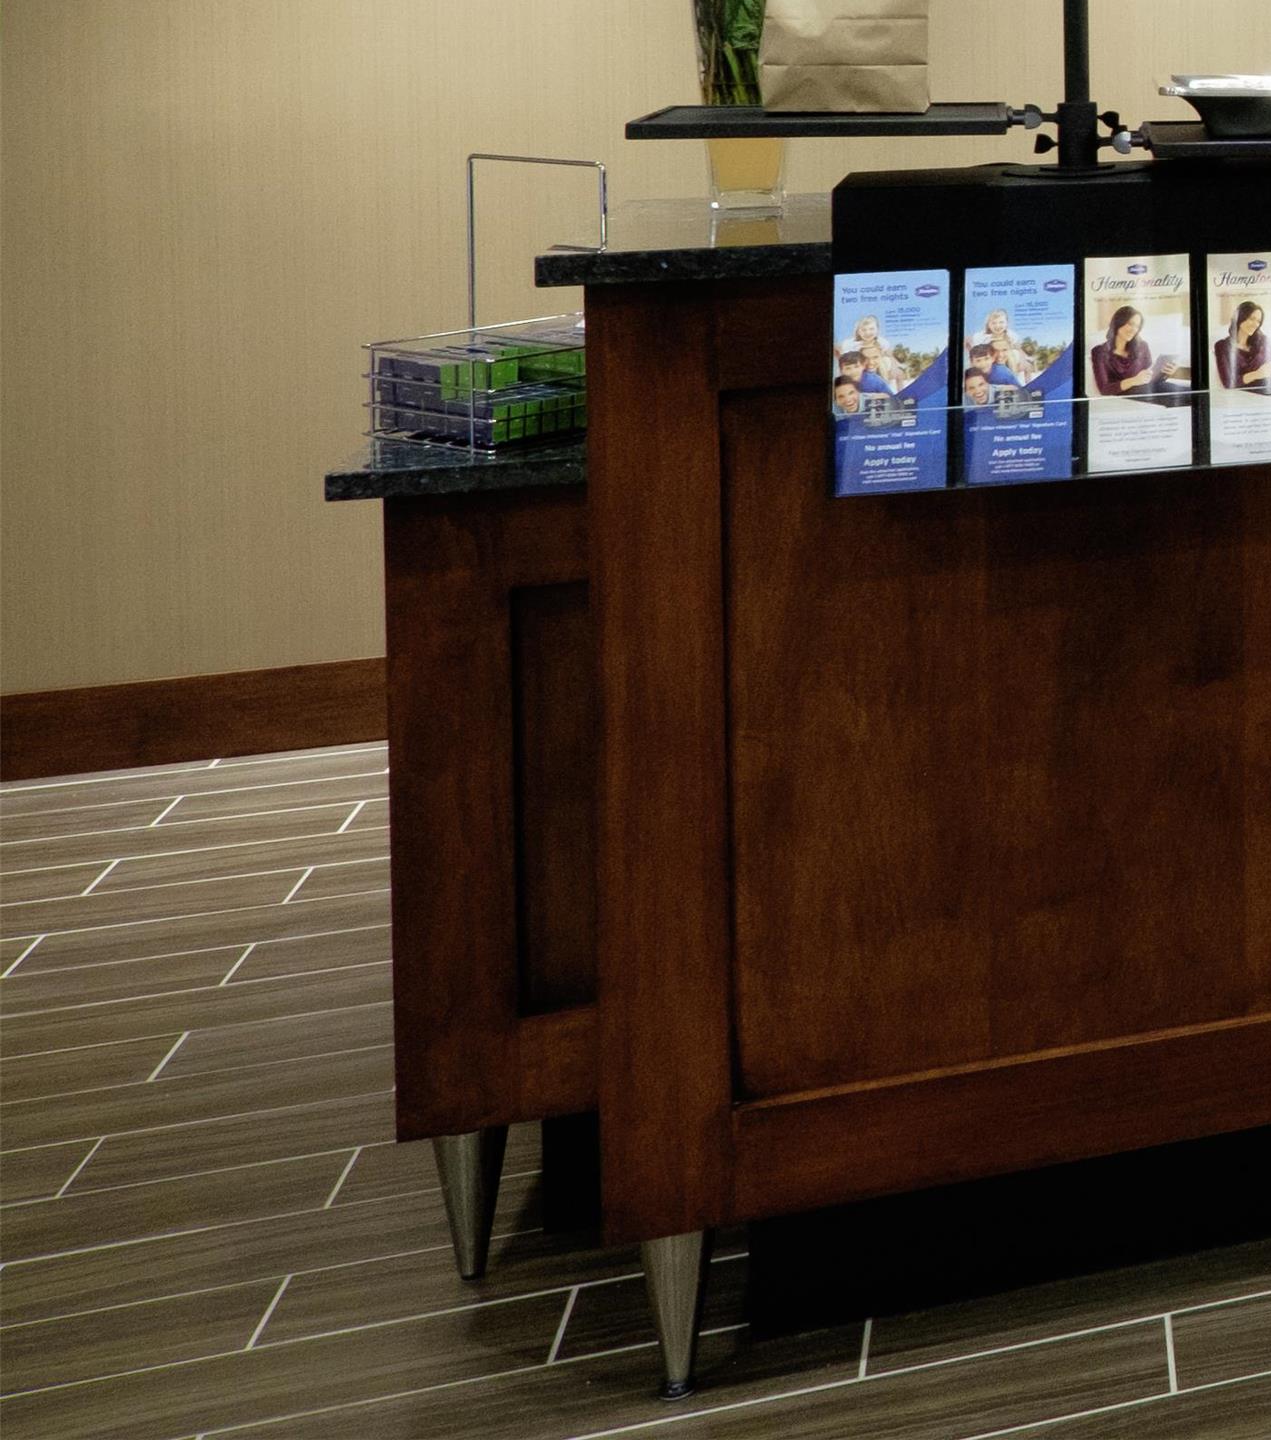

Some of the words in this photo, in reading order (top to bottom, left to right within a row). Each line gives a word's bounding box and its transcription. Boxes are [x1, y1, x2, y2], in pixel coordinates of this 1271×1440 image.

[992, 447, 1017, 457] Apply
[1019, 445, 1044, 455] today
[863, 457, 889, 467] Apply
[891, 455, 917, 465] today
